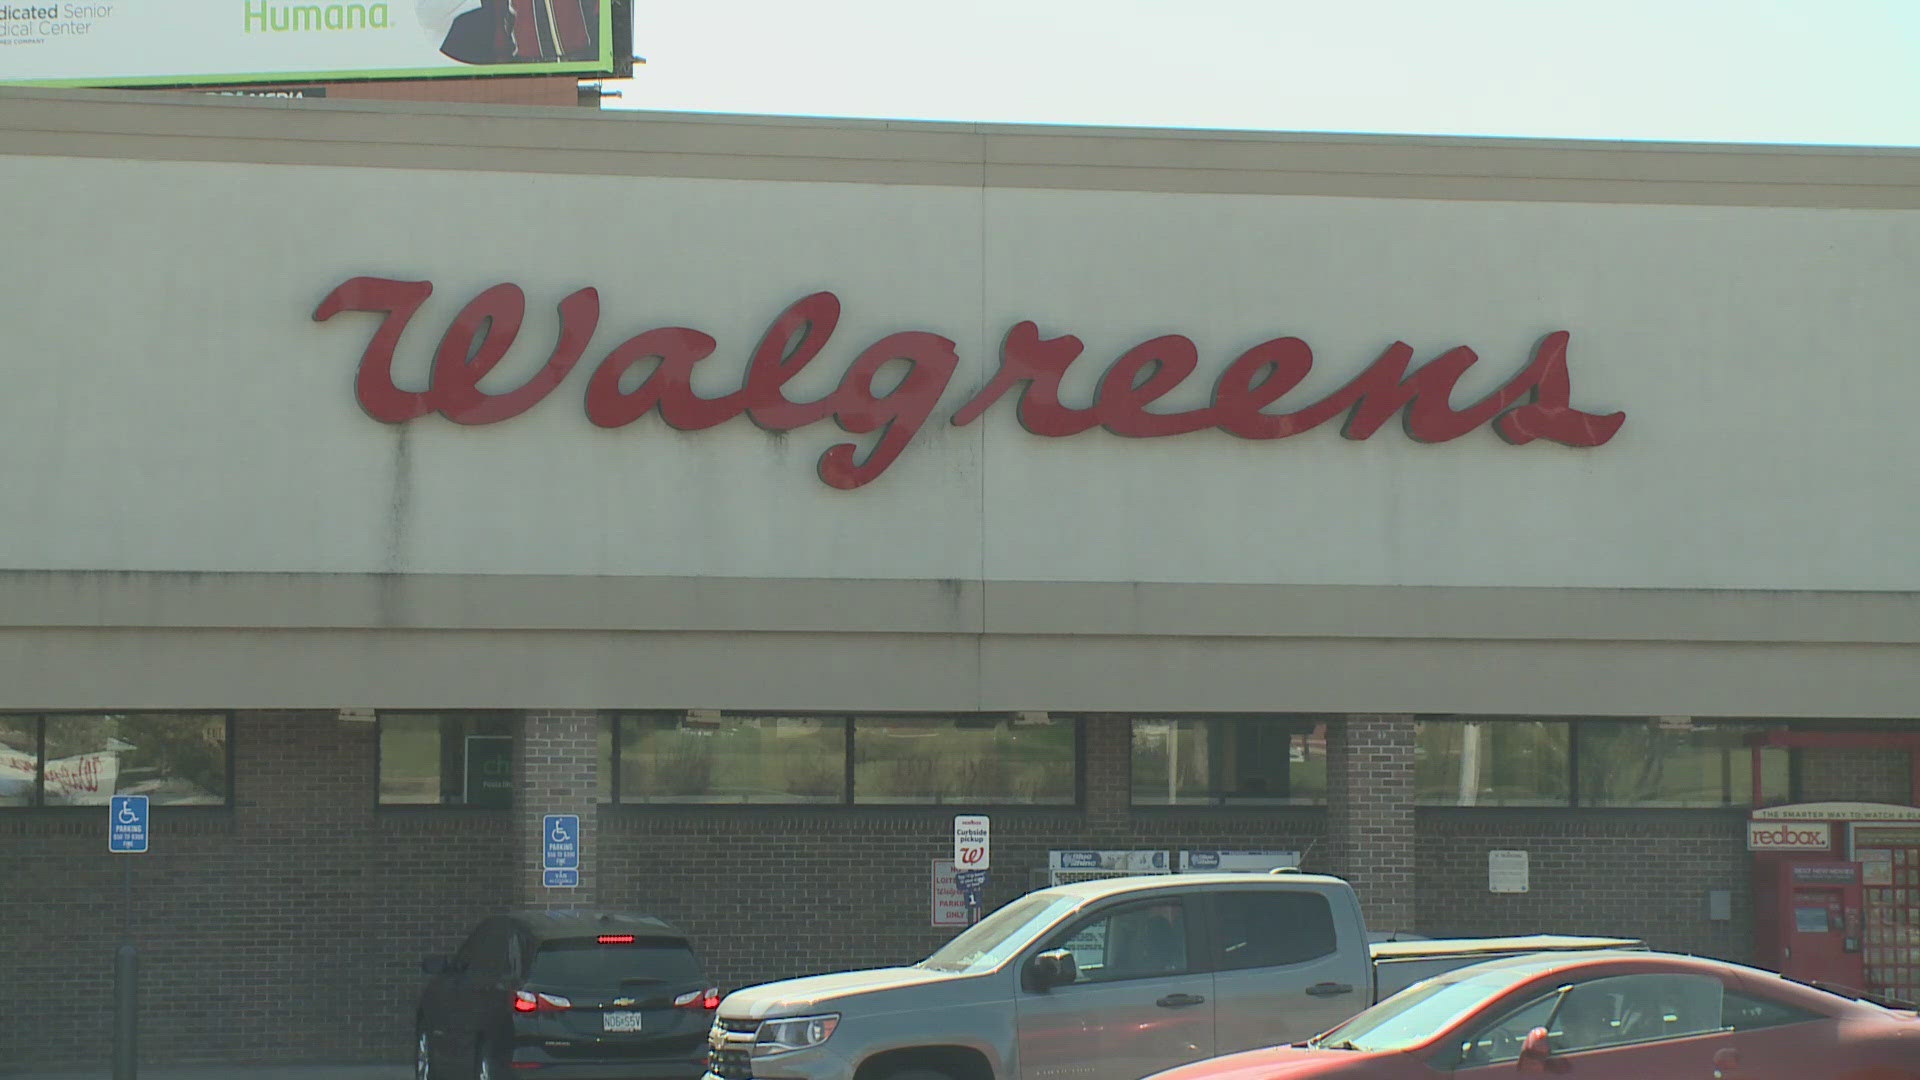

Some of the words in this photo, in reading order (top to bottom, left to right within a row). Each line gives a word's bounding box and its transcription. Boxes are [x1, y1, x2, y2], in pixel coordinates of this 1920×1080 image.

[0, 4, 58, 20] dicated
[64, 3, 113, 19] Senior
[244, 0, 389, 33] Humana
[0, 22, 32, 37] dical
[39, 20, 91, 36] Center
[312, 275, 1626, 491] Walgreens
[116, 825, 142, 833] PARKING
[549, 843, 574, 851] PARKING
[969, 895, 977, 905] 1
